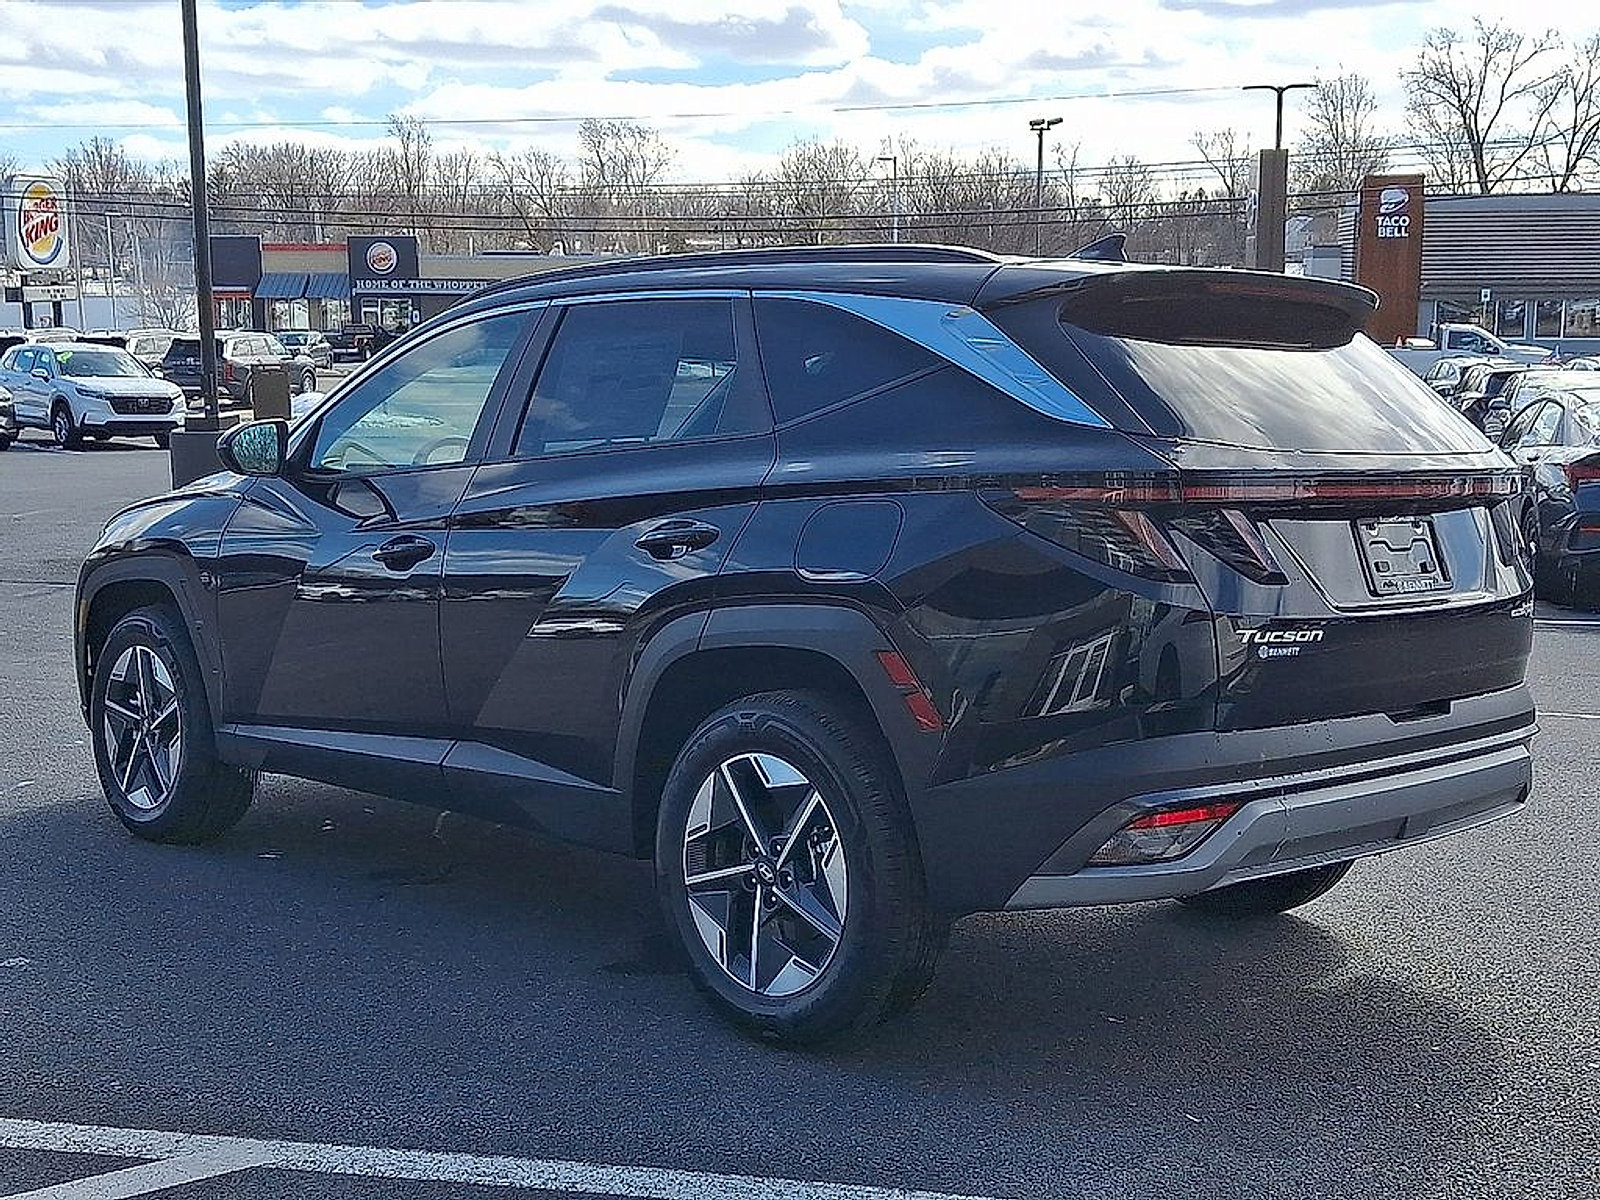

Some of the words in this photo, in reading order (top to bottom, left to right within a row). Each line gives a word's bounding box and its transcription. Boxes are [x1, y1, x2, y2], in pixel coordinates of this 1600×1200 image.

[1375, 215, 1411, 227] TACO
[24, 215, 59, 248] KING
[1377, 226, 1409, 237] BELL
[356, 279, 389, 289] HOME
[391, 279, 406, 289] OF
[408, 279, 431, 289] THE
[433, 280, 488, 290] WHOPPER
